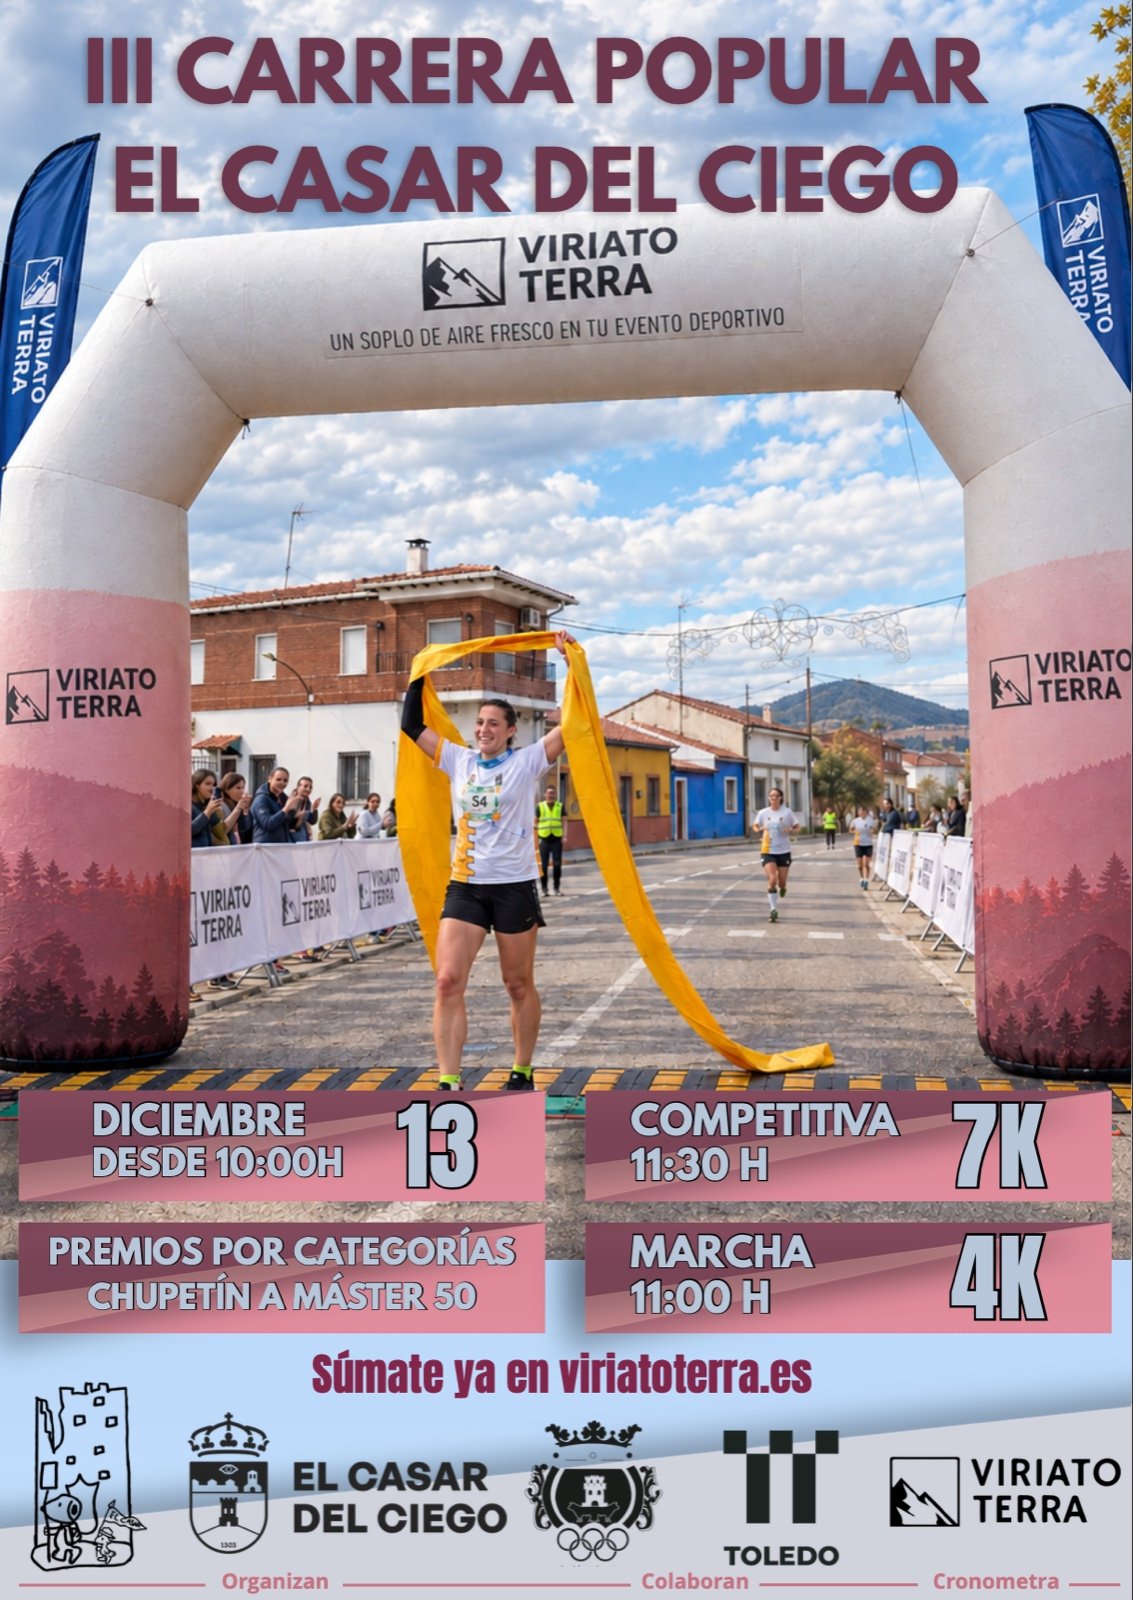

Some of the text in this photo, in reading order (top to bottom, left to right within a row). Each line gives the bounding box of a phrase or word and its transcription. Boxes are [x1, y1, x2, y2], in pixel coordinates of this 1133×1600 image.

[518, 226, 678, 263] VIRIATO
[518, 263, 653, 303] TERRA
[1087, 245, 1114, 333] VIRIATO
[330, 307, 785, 351] UN SOPLO DE AIRE FRESCO EN TU EVENTO DEPORTIVO
[11, 314, 36, 395] TERRA
[31, 313, 56, 404] VIRIATO
[1034, 648, 1131, 675] VIRIATO
[56, 668, 157, 692] VIRIATO
[1037, 676, 1122, 703] TERRA
[56, 695, 142, 719] TERRA
[301, 873, 337, 898] VIRIATO
[371, 867, 400, 887] VIRIATO
[201, 884, 251, 915] VIRIATO
[302, 897, 332, 922] TERRA
[201, 913, 243, 944] TERRA
